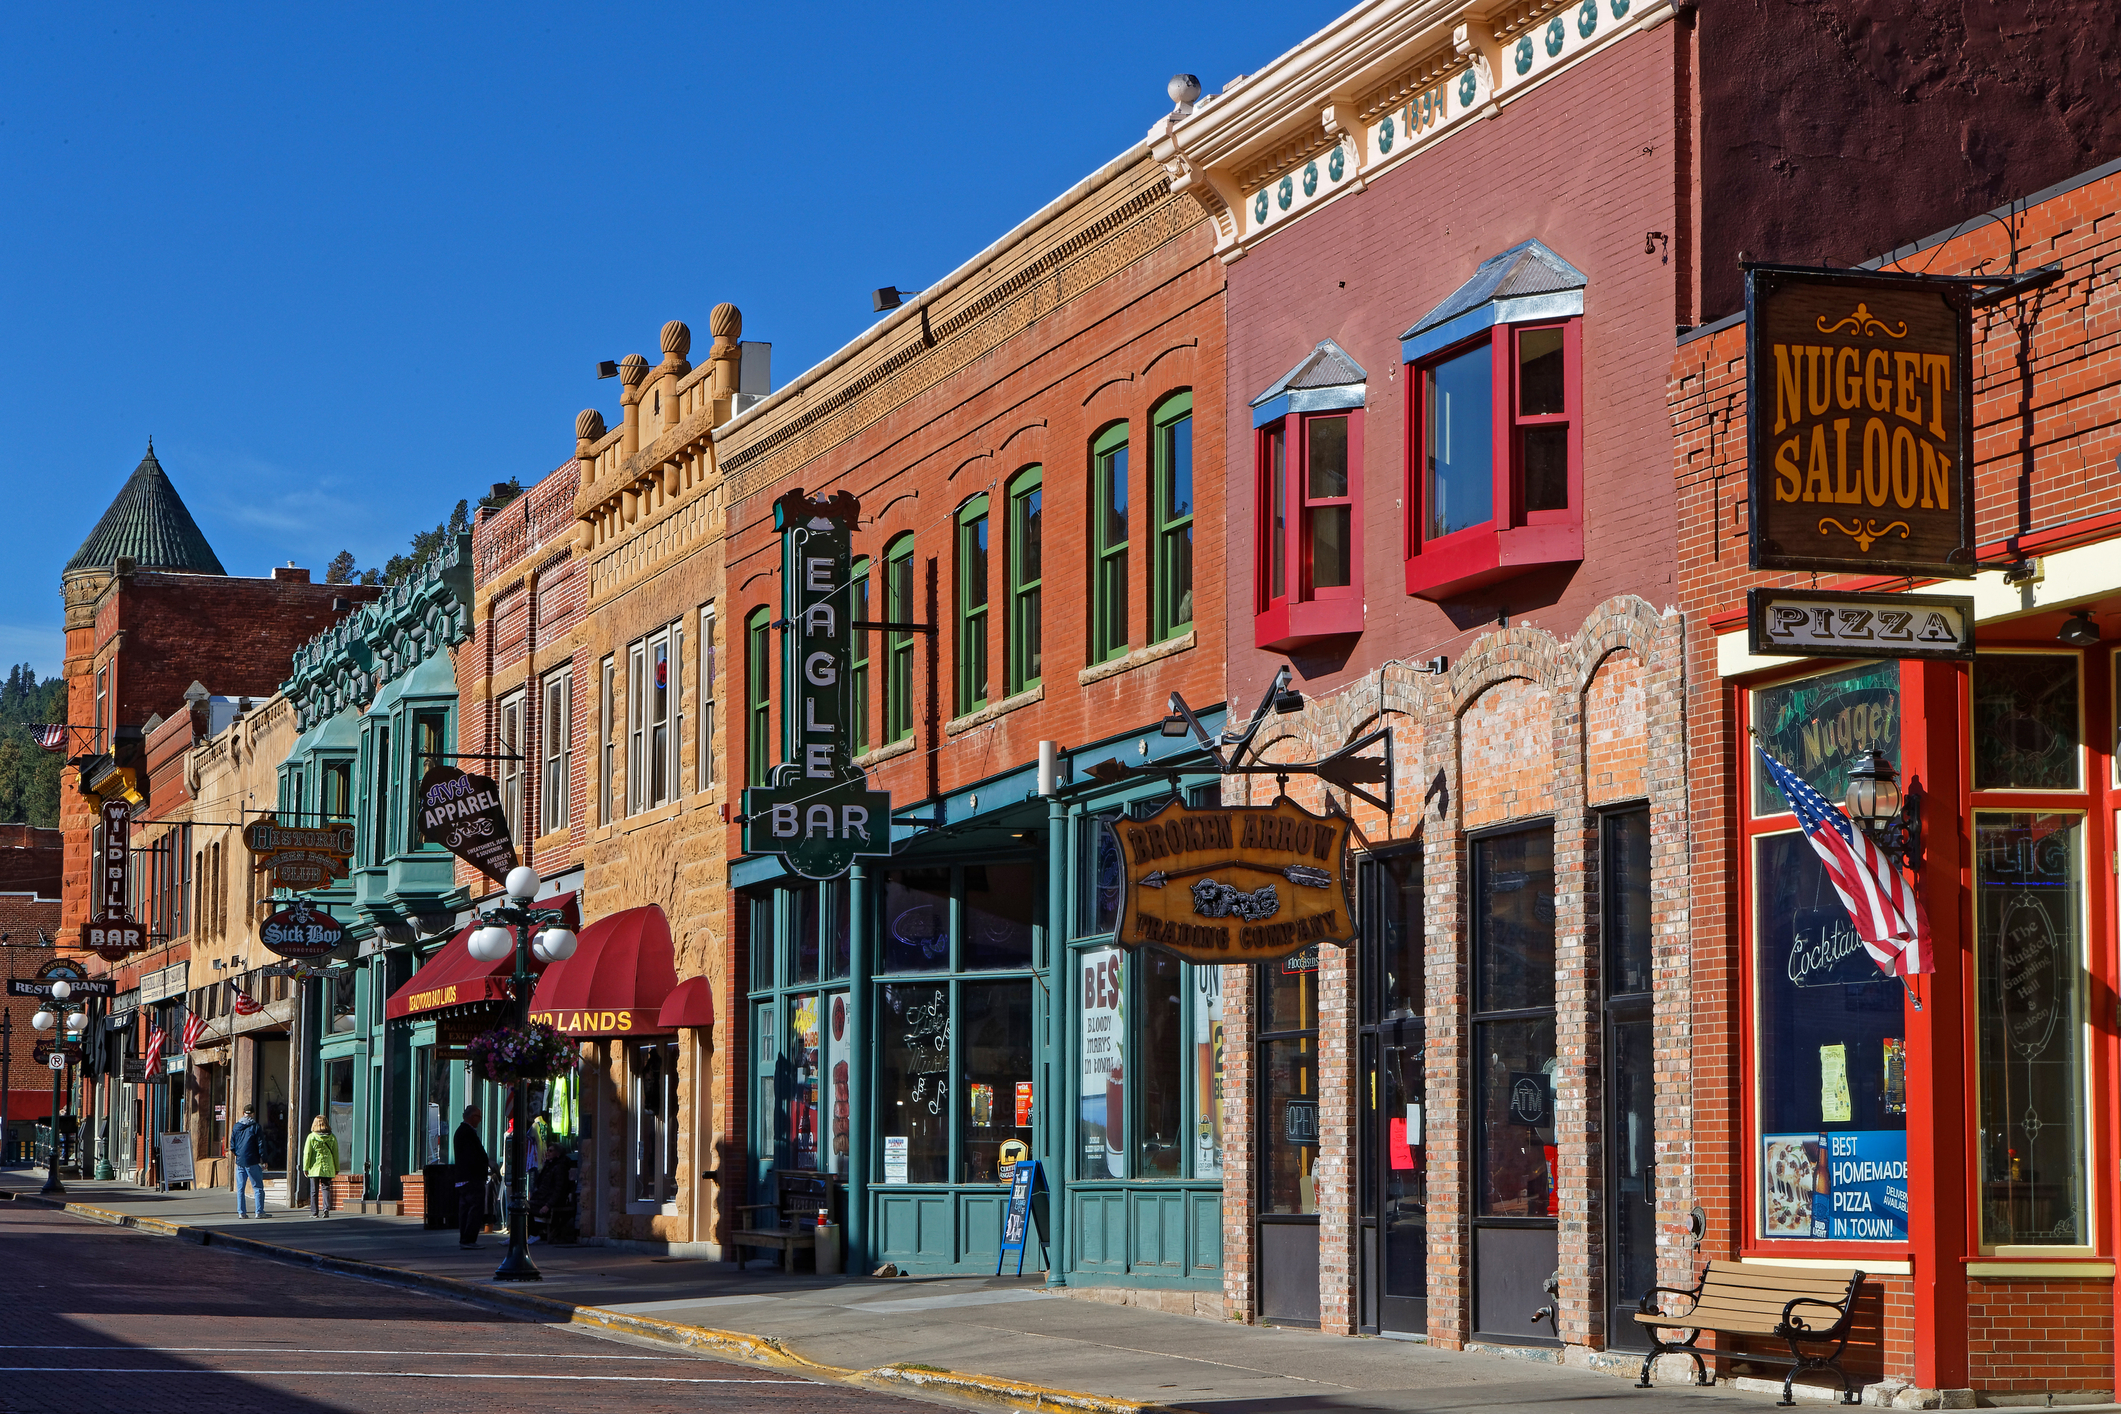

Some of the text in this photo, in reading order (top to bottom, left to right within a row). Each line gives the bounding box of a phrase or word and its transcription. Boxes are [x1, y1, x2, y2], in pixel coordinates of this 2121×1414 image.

[1402, 83, 1447, 140] 1894
[1773, 343, 1951, 442] NUGGET
[1774, 417, 1952, 510] SALOON
[1769, 605, 1957, 643] PIZZA
[804, 556, 836, 779] EAGLE
[1803, 694, 1896, 772] Nugget
[427, 775, 474, 806] AVA
[425, 790, 499, 828] APPAREL
[772, 802, 871, 840] BAR
[251, 826, 355, 853] HISTORIC
[1128, 814, 1337, 865] BROKEN ARROW
[108, 807, 124, 919] WILD BILL
[281, 866, 321, 881] CLUB
[493, 859, 509, 869] BIKER
[90, 929, 139, 946] BAR
[263, 922, 341, 946] Sick Boy
[1137, 909, 1339, 949] TRADING COMPANY
[2008, 921, 2039, 943] The
[2002, 934, 2051, 971] Nugget
[42, 960, 83, 974] OYSTER BAY
[2003, 955, 2051, 990] Gambling
[16, 982, 108, 994] RESTRANT
[1085, 953, 1121, 1010] BES
[2017, 979, 2041, 999] Hall
[2027, 1000, 2037, 1011] &
[557, 1011, 632, 1031] LANDS
[1087, 1016, 1112, 1033] BLOODY
[2014, 1008, 2049, 1035] Saloon
[39, 1041, 79, 1052] DEAOOD
[1087, 1036, 1111, 1053] MARY'S
[1510, 1088, 1542, 1112] ATM
[1289, 1106, 1318, 1135] OPEN
[1832, 1136, 1858, 1157] BEST
[1833, 1161, 1908, 1187] HOMEMADE
[1833, 1191, 1873, 1212] PIZZA
[1883, 1195, 1908, 1213] AVAILABL
[1812, 1228, 1827, 1238] LIGHT
[1815, 1220, 1825, 1229] BUD
[1834, 1219, 1893, 1238] IN TOWN!
